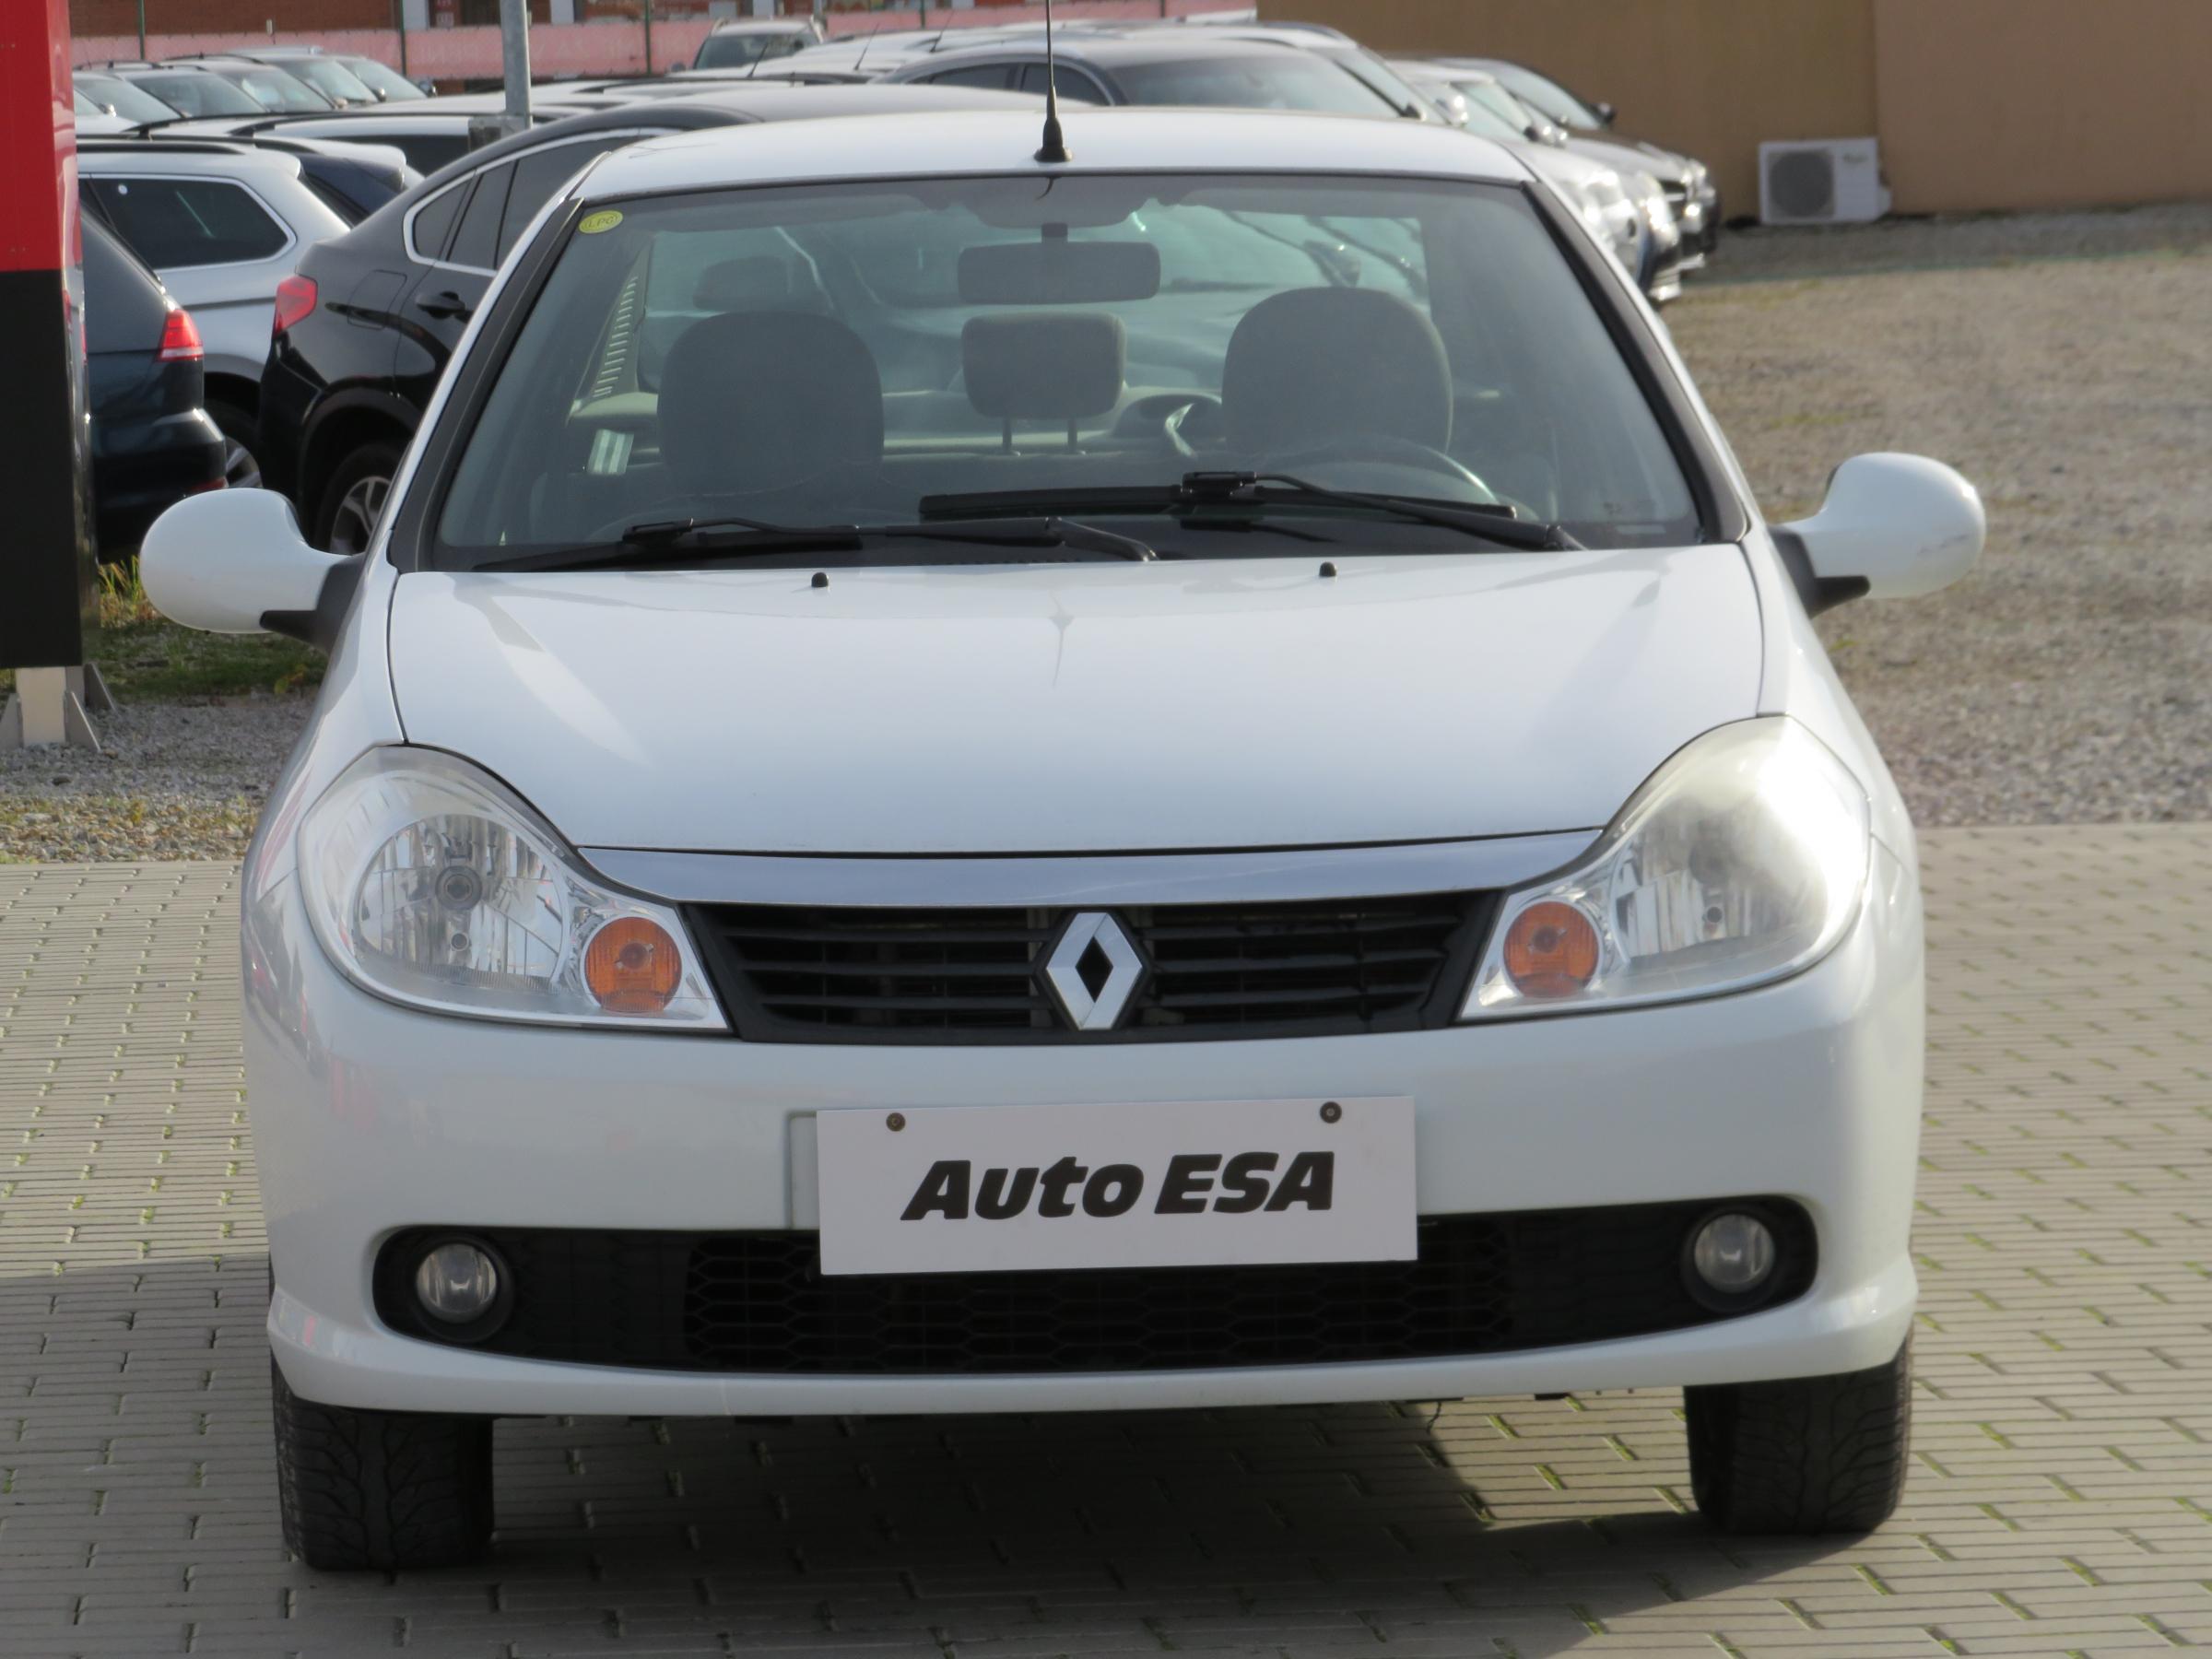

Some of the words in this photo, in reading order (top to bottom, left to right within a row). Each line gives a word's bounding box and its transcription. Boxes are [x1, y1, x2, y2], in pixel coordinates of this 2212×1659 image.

[587, 215, 615, 229] LPG
[900, 1156, 1145, 1221] Auto
[1153, 1151, 1335, 1215] ESA
